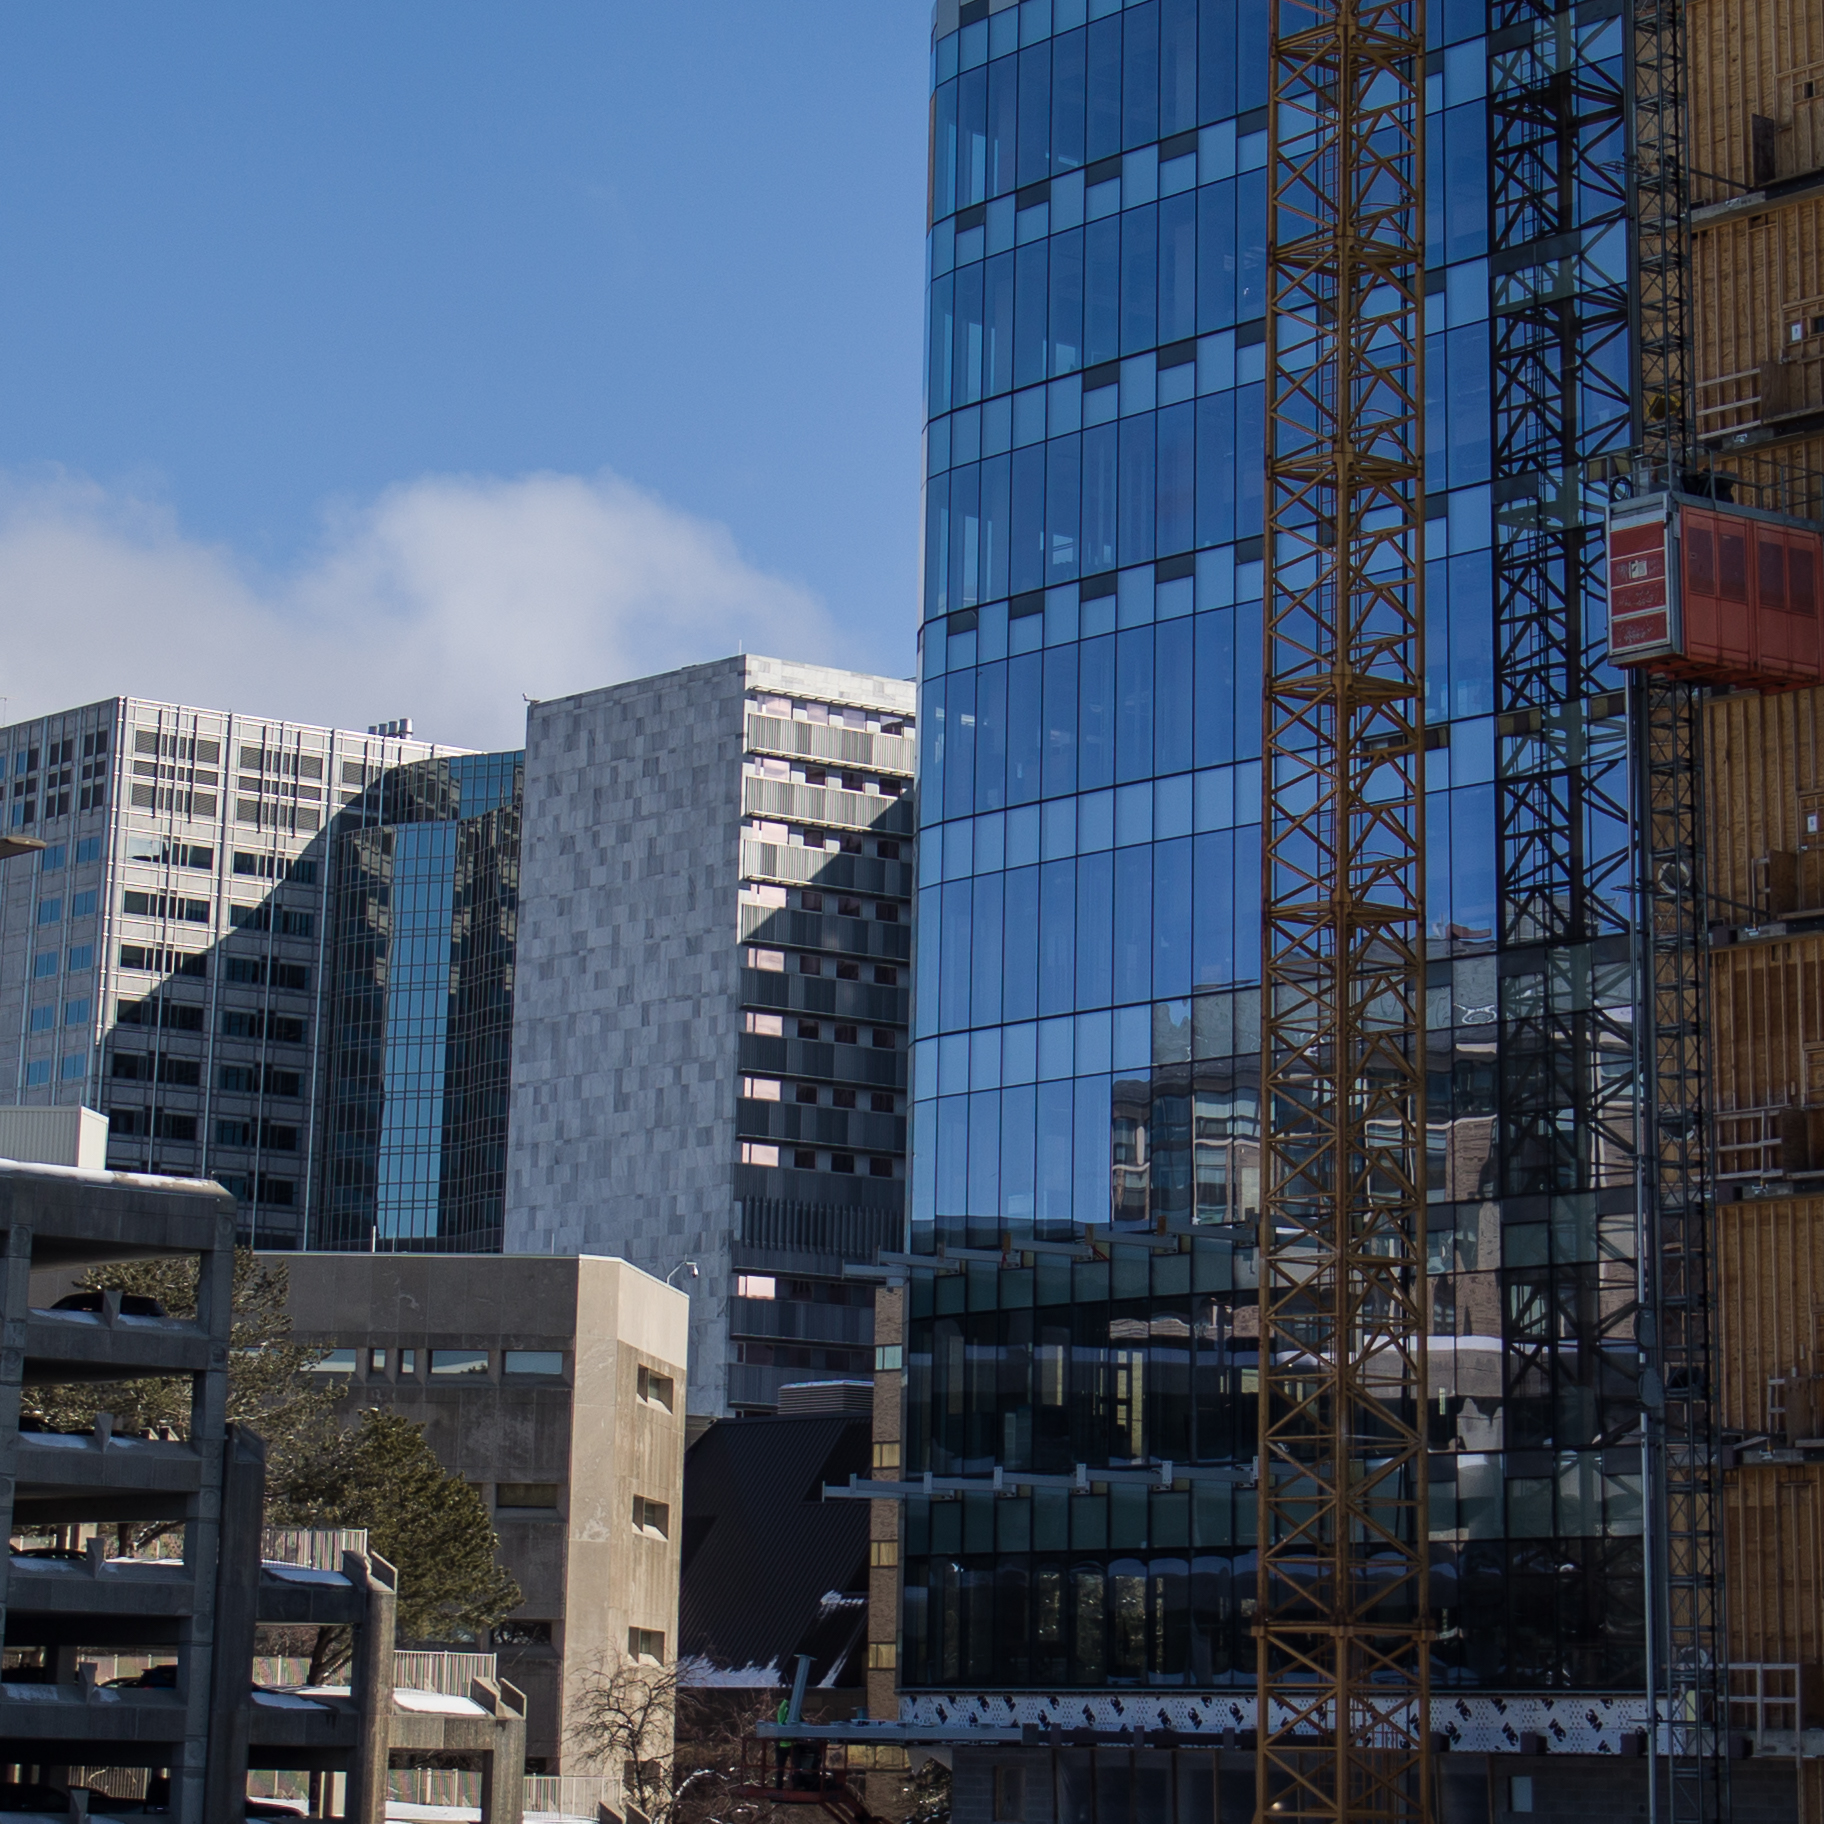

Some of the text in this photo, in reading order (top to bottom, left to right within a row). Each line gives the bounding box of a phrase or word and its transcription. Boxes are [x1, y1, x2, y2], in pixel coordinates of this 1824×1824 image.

[1445, 1721, 1461, 1744] 3M
[1548, 1718, 1566, 1743] 3M
[1585, 1708, 1603, 1733] 3M
[1502, 1722, 1519, 1746] 3M
